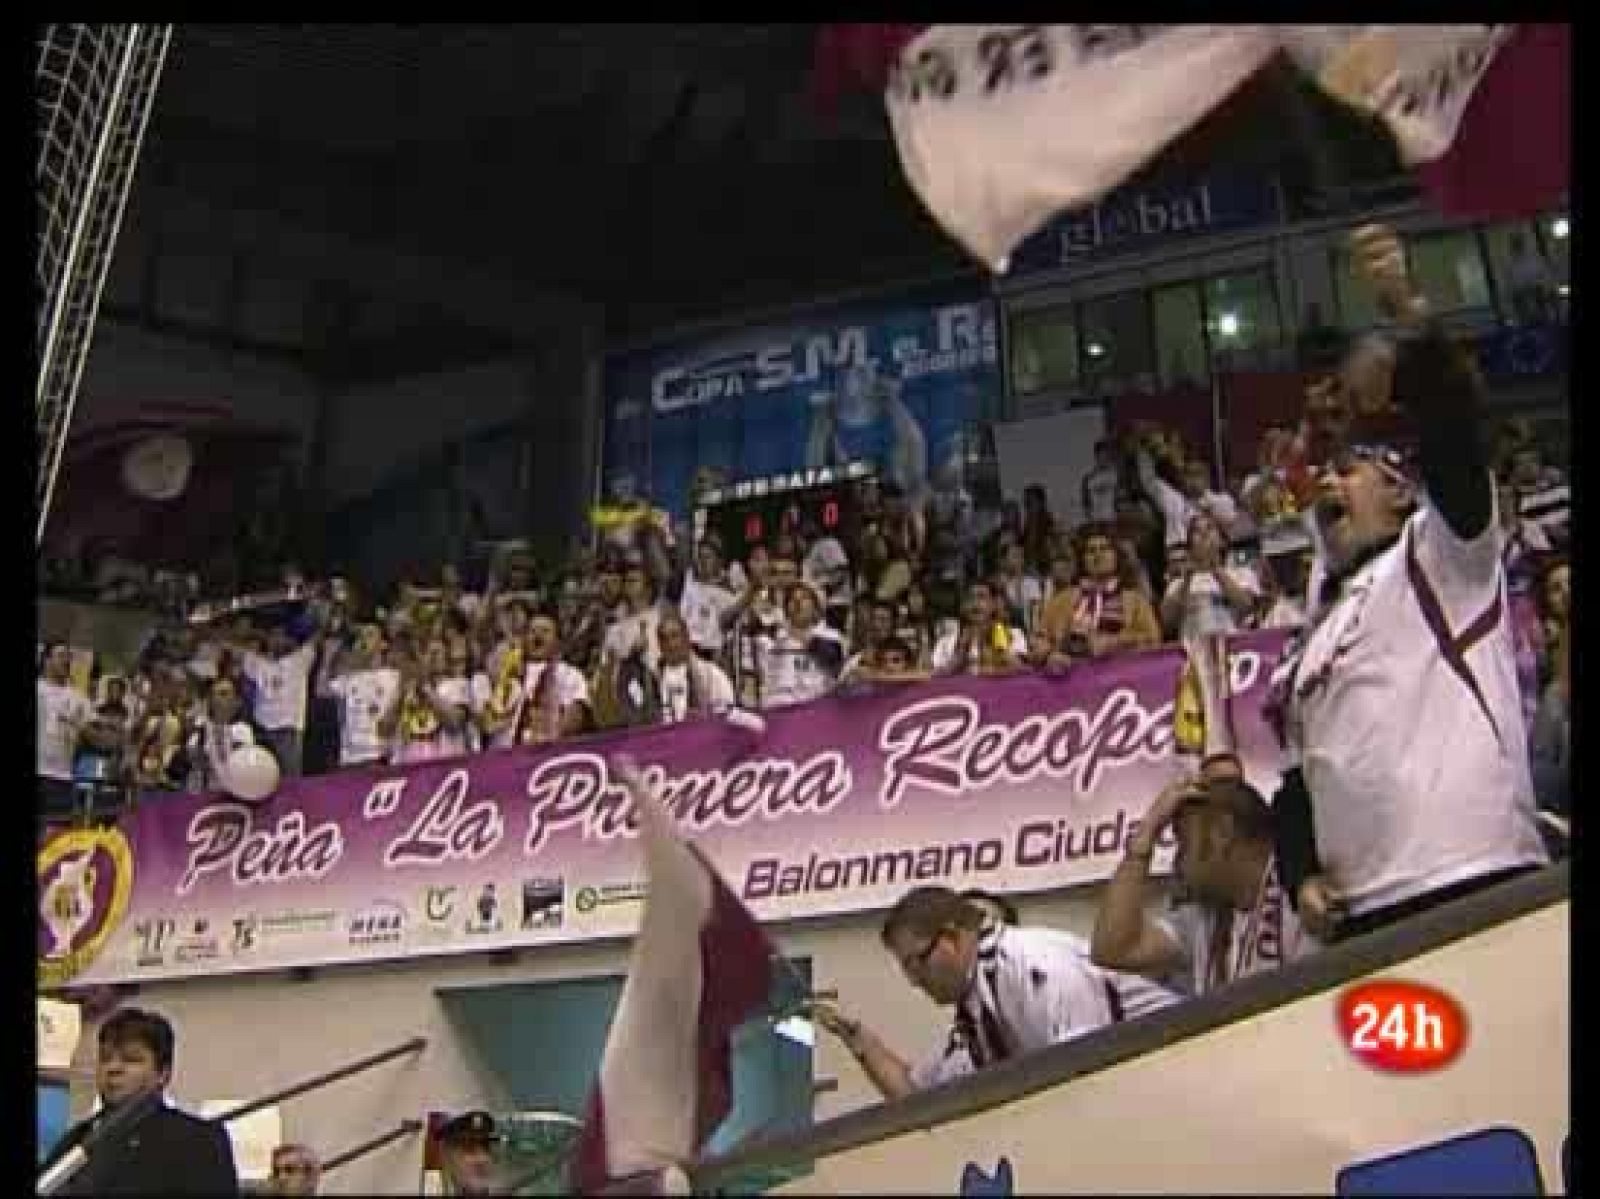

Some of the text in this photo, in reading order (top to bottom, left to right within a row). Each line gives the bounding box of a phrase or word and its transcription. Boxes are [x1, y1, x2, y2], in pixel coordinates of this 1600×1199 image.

[176, 803, 342, 894] Peña
[524, 752, 851, 853] Primera
[744, 838, 1003, 899] Balonmano
